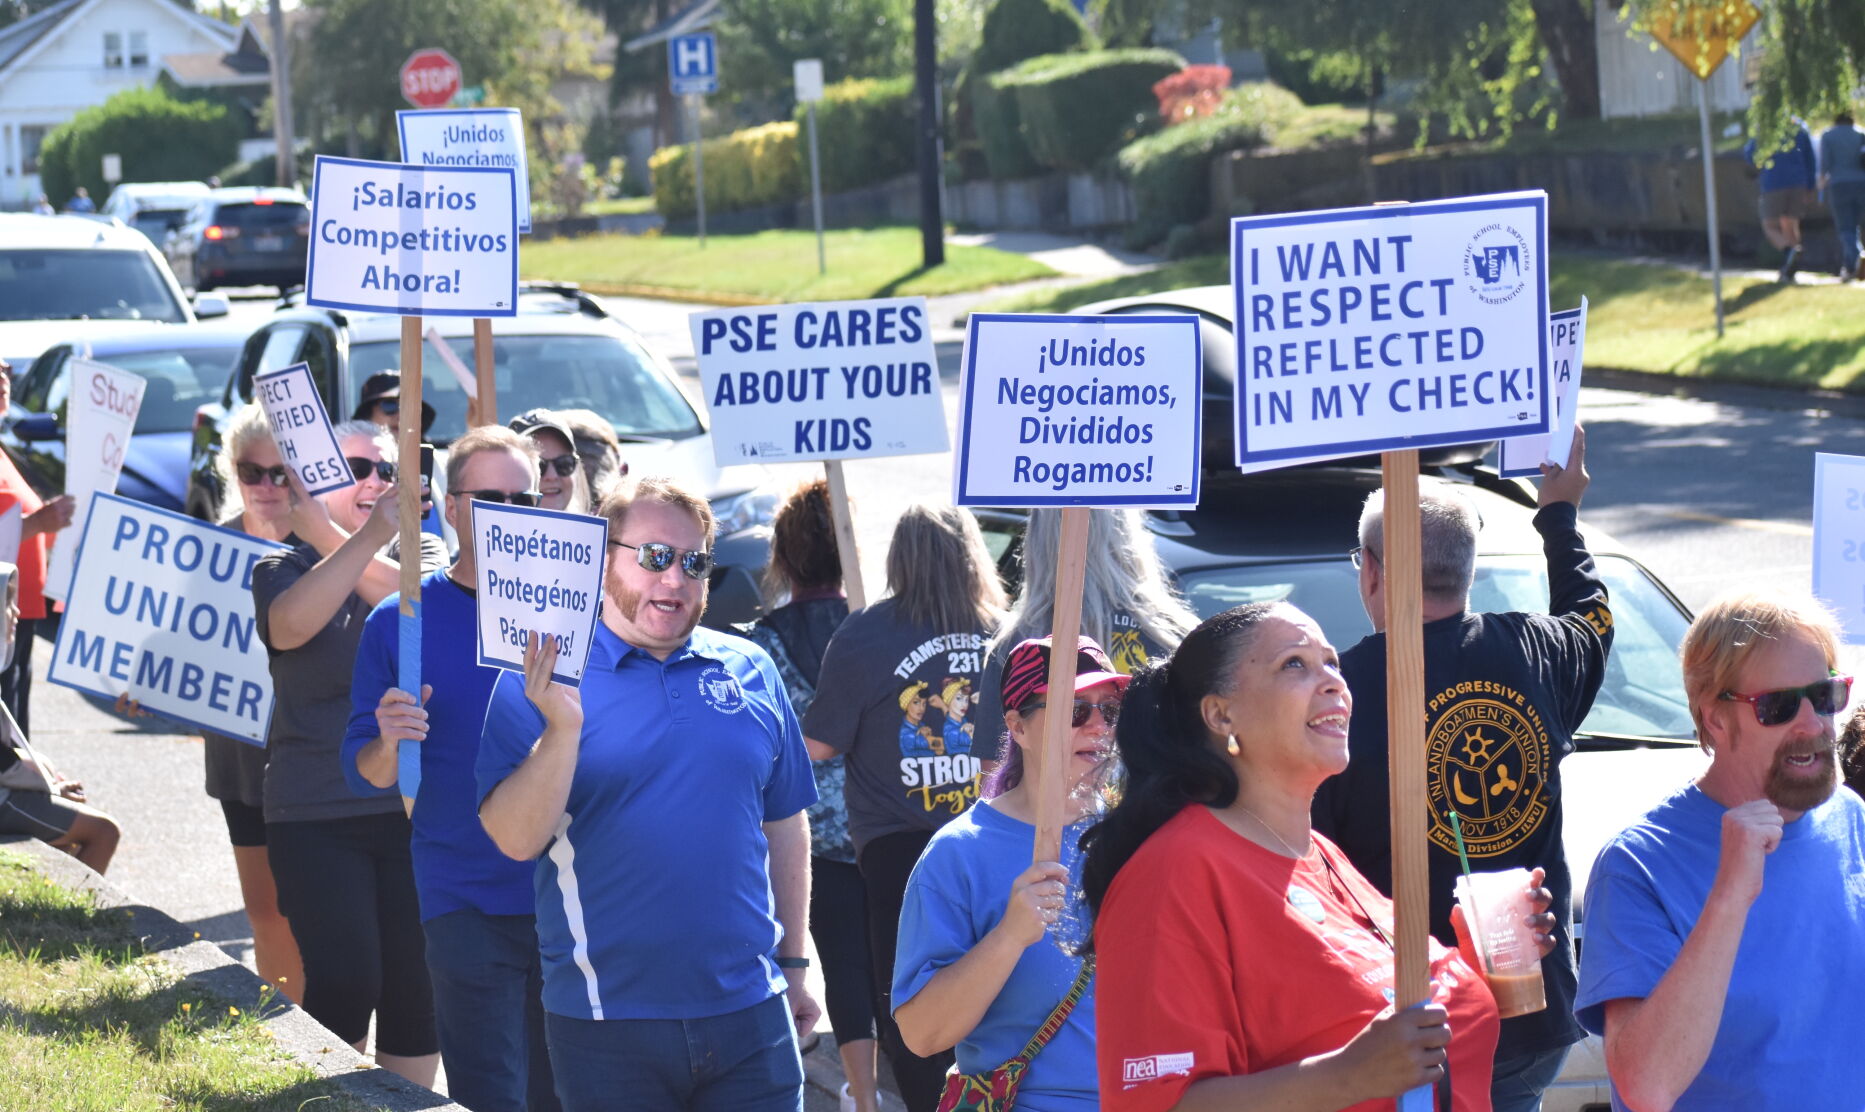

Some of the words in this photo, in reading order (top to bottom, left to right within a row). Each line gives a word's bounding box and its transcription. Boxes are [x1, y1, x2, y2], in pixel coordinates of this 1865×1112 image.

[678, 40, 707, 75] H
[404, 66, 458, 94] STOP
[442, 124, 505, 149] ¡Unidos
[353, 181, 477, 211] ¡Salarios
[321, 219, 507, 256] Competitivos
[1463, 243, 1473, 276] PUBLIC
[1473, 224, 1502, 241] SCHOOL
[1506, 226, 1530, 271] EMPLOYEES
[1251, 248, 1259, 285] I
[1277, 235, 1413, 282] WANT
[1488, 249, 1499, 278] PSE
[360, 265, 461, 294] Ahora!
[1478, 281, 1525, 305] WASHINGTON
[1251, 278, 1454, 333] RESPECT
[702, 314, 778, 355] PSE
[794, 305, 923, 349] CARES
[1039, 338, 1146, 373] ¡Unidos
[1253, 327, 1485, 379] REFLECTED
[713, 367, 830, 407] ABOUT
[841, 362, 932, 399] YOUR
[997, 377, 1177, 413] Negociamos,
[1254, 390, 1293, 426] IN
[1312, 383, 1372, 421] MY
[1388, 367, 1535, 413] CHECK!
[794, 417, 872, 454] KIDS
[1019, 416, 1153, 444] Divididos
[293, 457, 342, 487] GES
[1013, 455, 1154, 491] Rogamos!
[486, 525, 592, 566] ¡Repétanos
[487, 569, 588, 613] Protegénos
[104, 575, 256, 655] UNION
[1114, 614, 1141, 629] LOC
[499, 617, 575, 658] Págos!
[894, 633, 980, 680] TEAMSTERS
[948, 652, 980, 673] 231
[66, 629, 264, 722] MEMBER
[1429, 681, 1526, 711] PROGRESSIVE
[1514, 723, 1537, 774] UNION
[1459, 819, 1487, 836] NOV
[1494, 806, 1521, 832] 1918
[1467, 838, 1513, 853] Division
[1521, 806, 1540, 834] ILWU
[1127, 1059, 1156, 1079] nea
